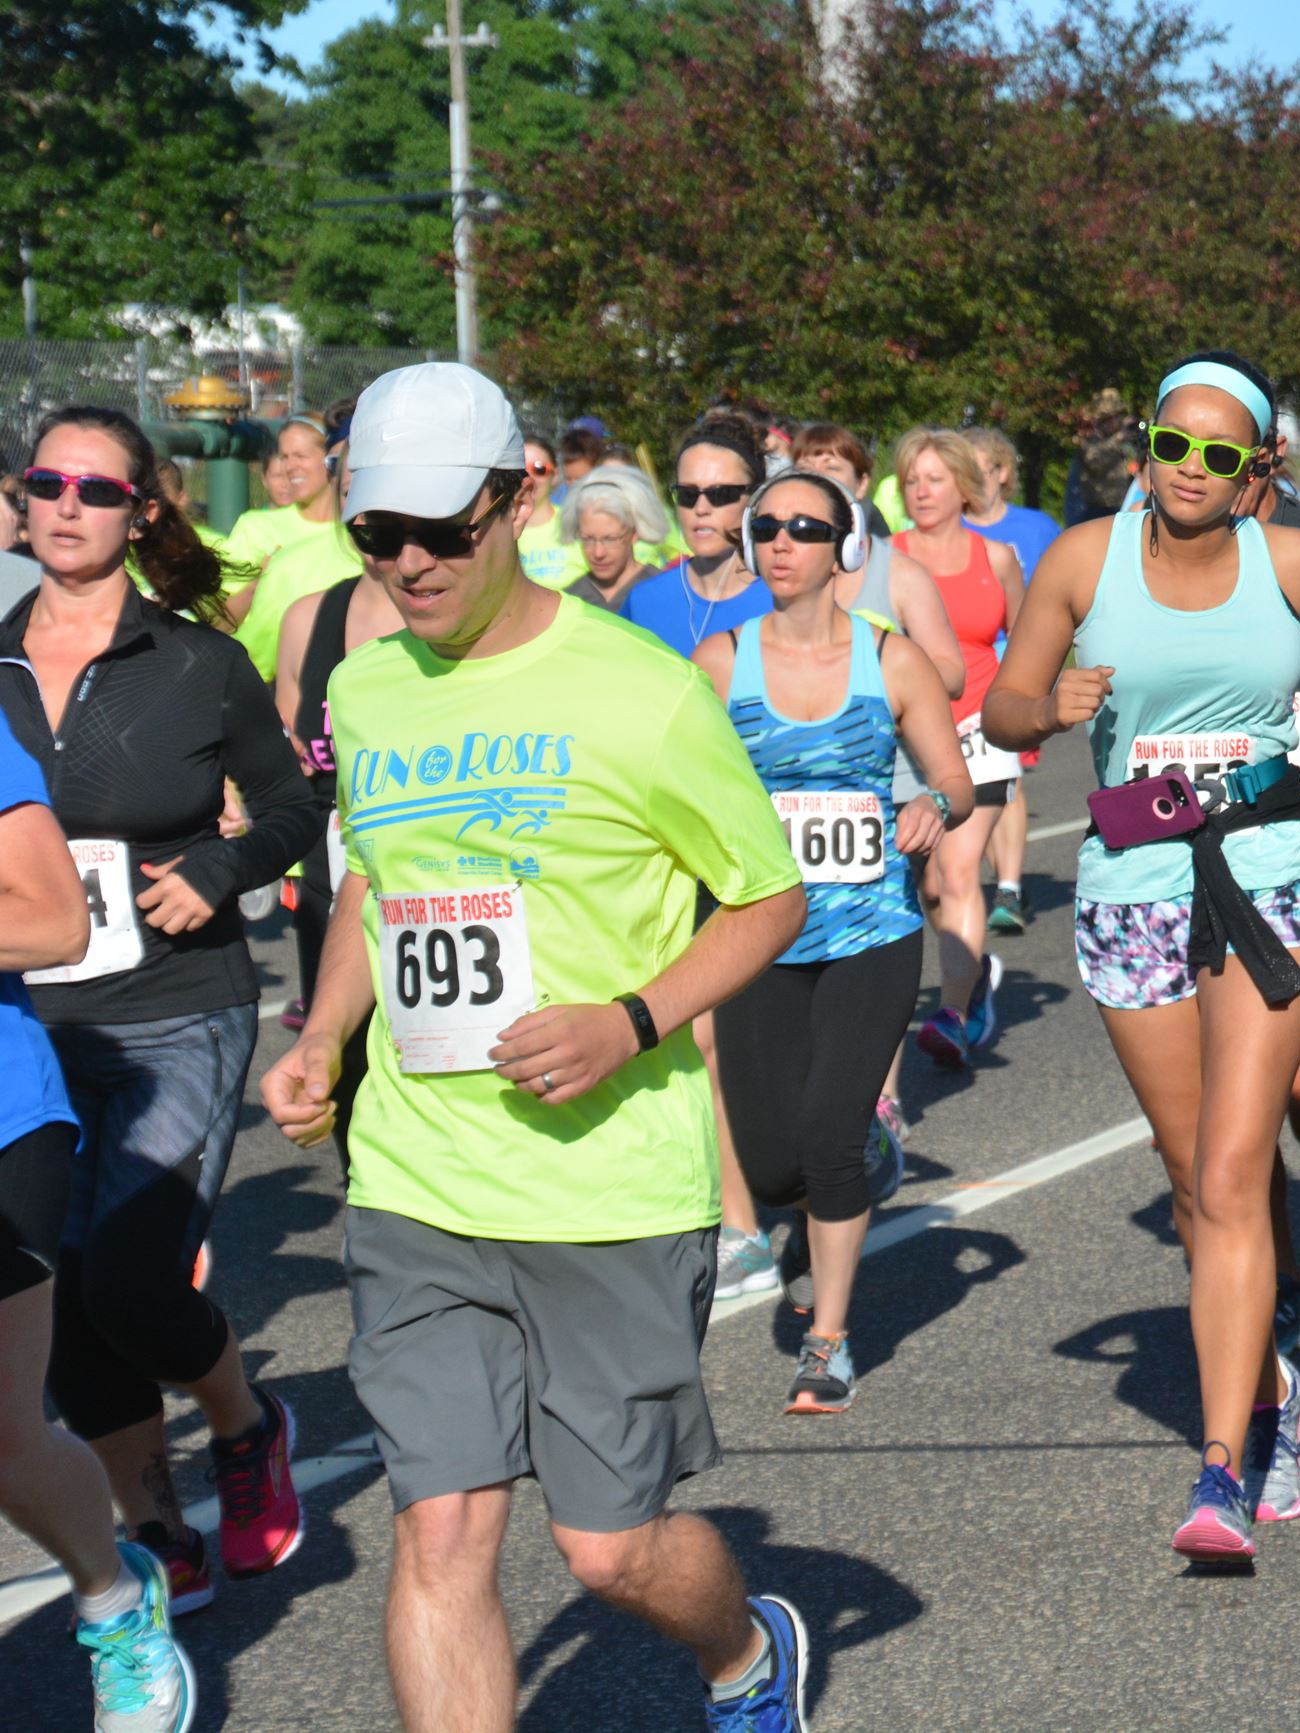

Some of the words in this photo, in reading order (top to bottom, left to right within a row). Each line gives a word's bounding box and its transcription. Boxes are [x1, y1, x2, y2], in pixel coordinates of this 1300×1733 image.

[455, 733, 575, 782] ROSES
[1135, 741, 1158, 759] RUN
[1163, 740, 1184, 759] FOR
[1190, 739, 1209, 758] THE
[1214, 738, 1249, 757] ROSES
[425, 751, 447, 769] for
[351, 745, 415, 807] RUN
[424, 764, 444, 779] the
[780, 797, 799, 812] RUN
[804, 797, 820, 812] FOR
[826, 797, 843, 812] THE
[847, 797, 878, 812] ROSES
[73, 843, 115, 862] ROSES
[380, 898, 405, 927] RUN
[405, 897, 428, 924] FOR
[429, 895, 457, 923] THE
[461, 891, 513, 921] ROSES
[396, 924, 504, 1009] 693
